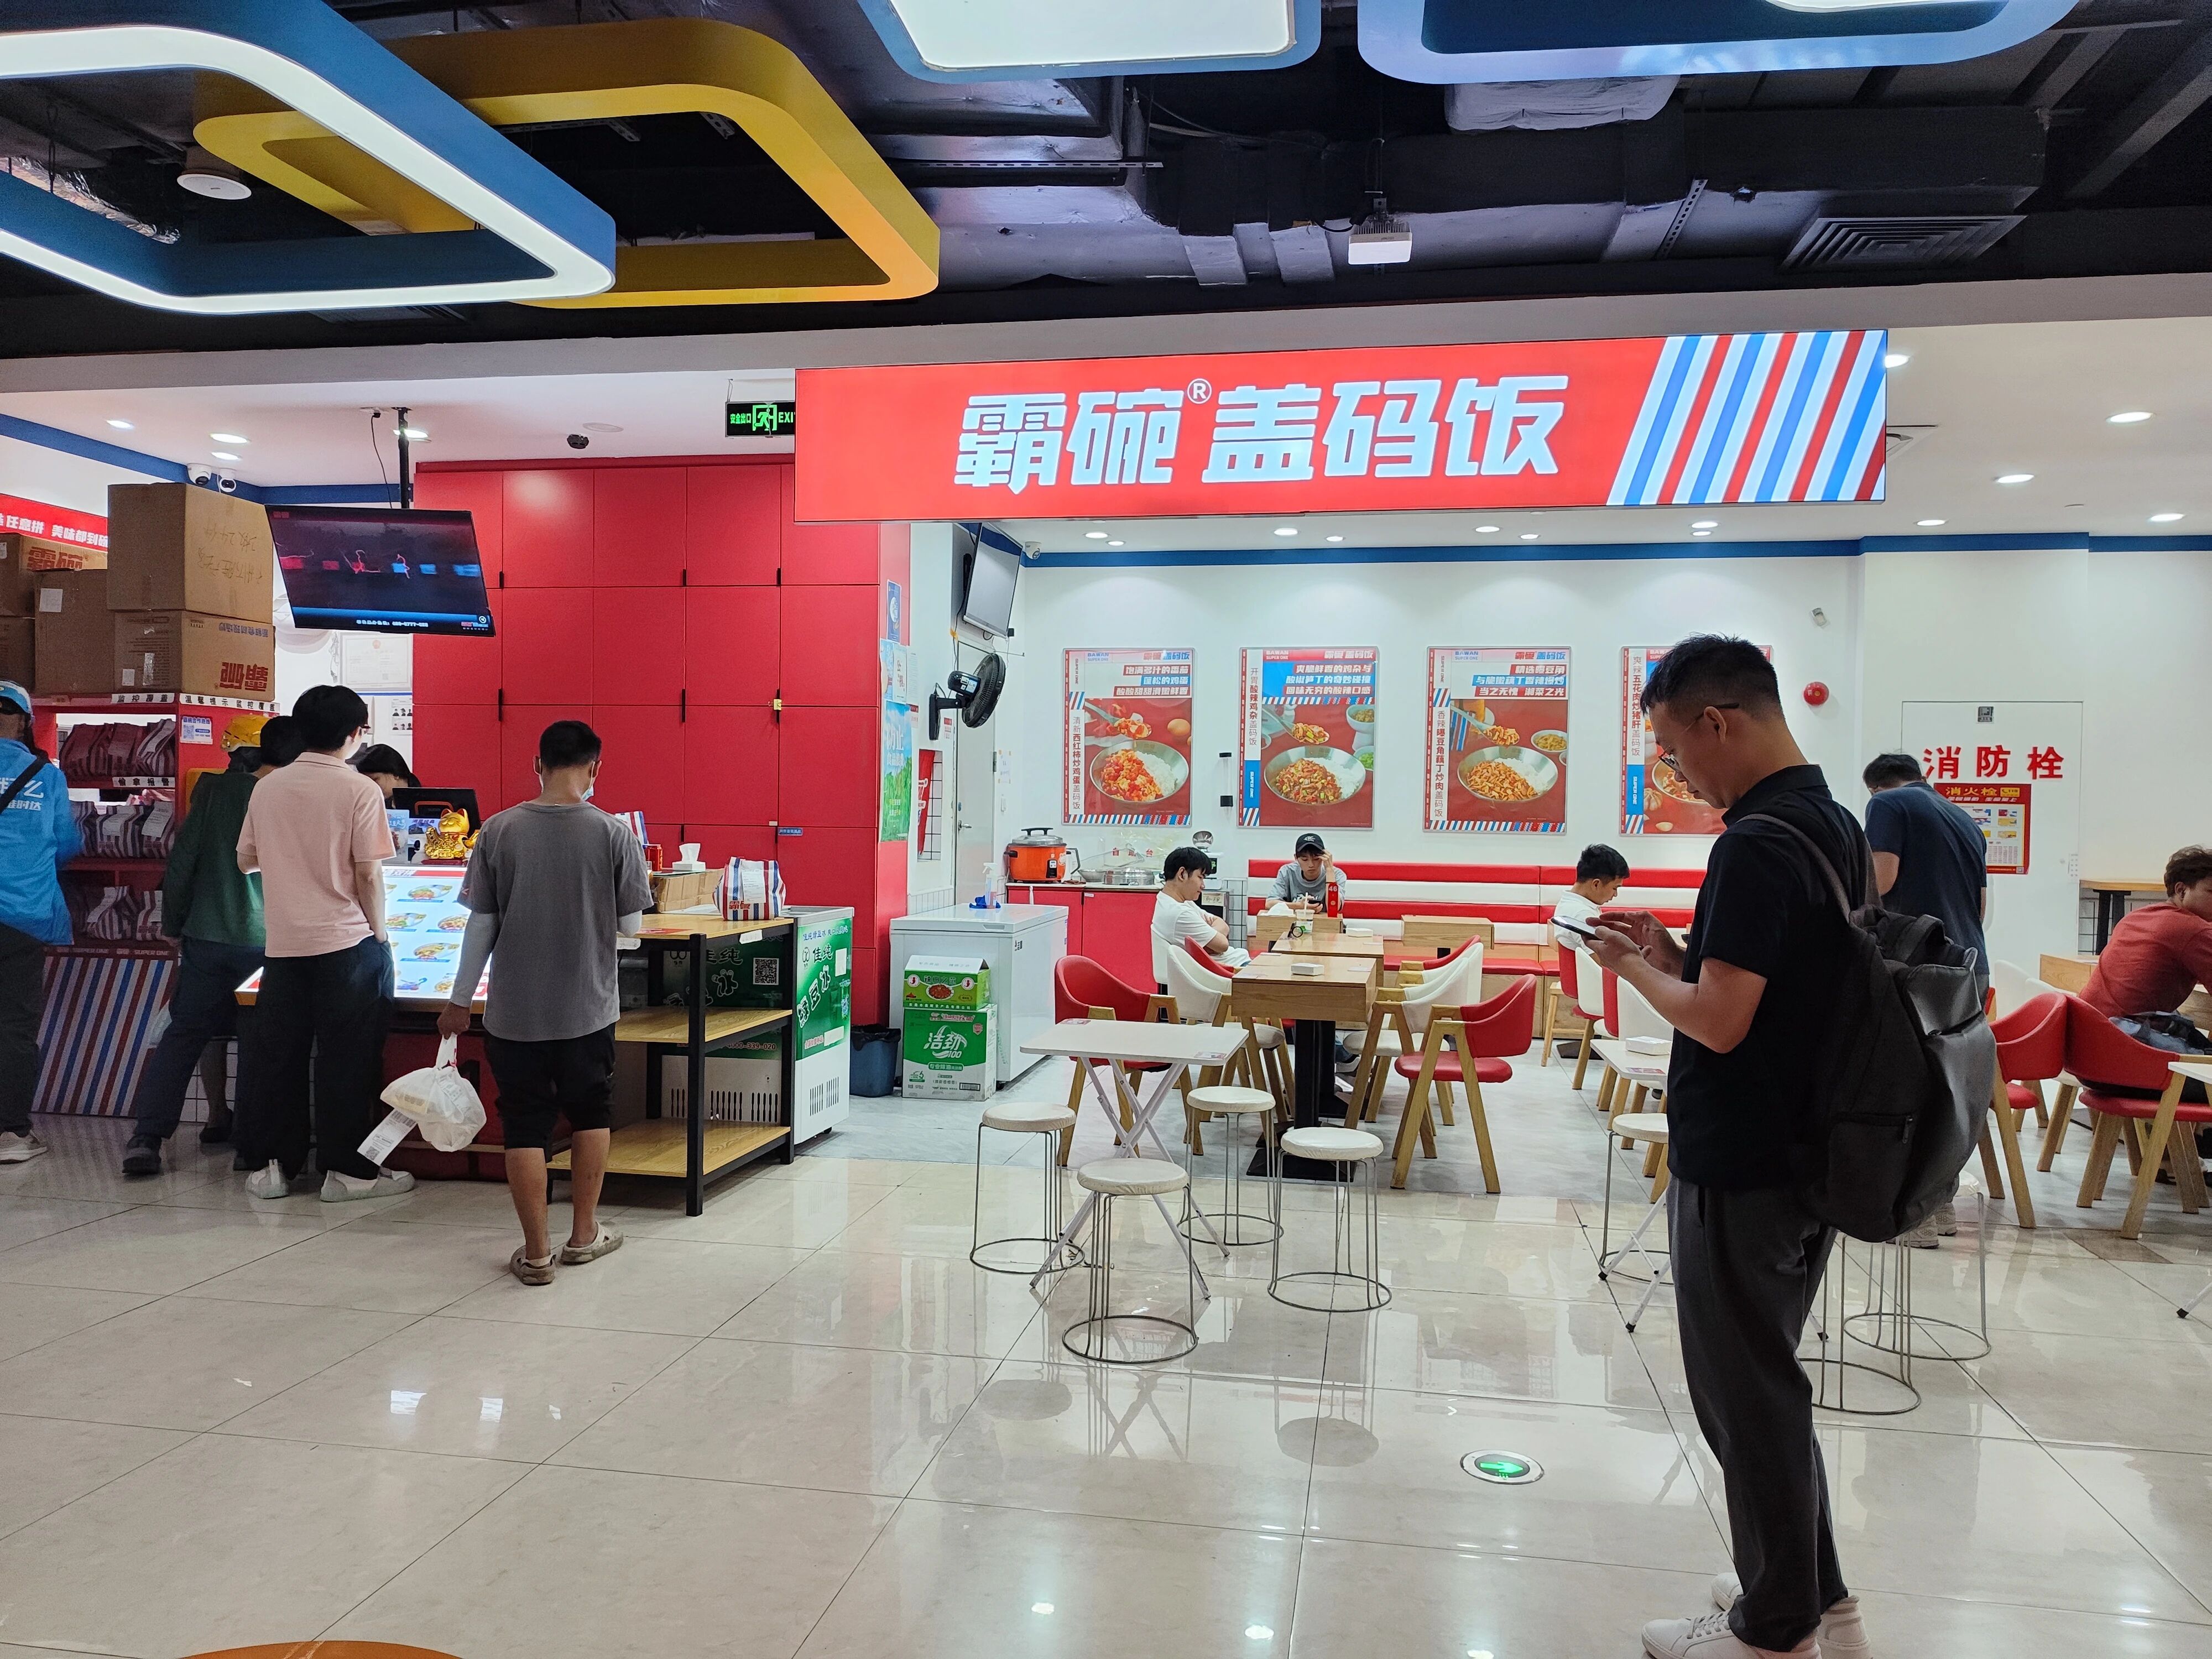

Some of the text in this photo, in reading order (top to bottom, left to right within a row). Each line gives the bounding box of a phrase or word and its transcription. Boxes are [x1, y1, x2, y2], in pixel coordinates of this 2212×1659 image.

[731, 413, 751, 424] 安全出口
[779, 412, 795, 422] EXI
[6, 515, 44, 534] 任意拼
[1296, 665, 1371, 673] 爽脆鲜香的鸡杂与
[1117, 687, 1188, 696] 酸酸甜甜滑嫩鲜香
[1286, 686, 1371, 695] 回味无穷的酸辣口感
[1479, 687, 1518, 696] 当之无愧
[118, 694, 168, 702] 监控覆盖
[185, 695, 275, 712] 温馨提示 监控覆盖
[1249, 668, 1258, 745] 开胃酸辣鸡杂盖码饭
[1631, 656, 1641, 756] 爽辣五花肉炒猪肝盖码饭
[1923, 745, 2064, 780] 消防栓
[1945, 787, 1997, 796] 消火栓
[813, 944, 833, 963] 佳纯
[924, 1031, 962, 1051] 洁劲
